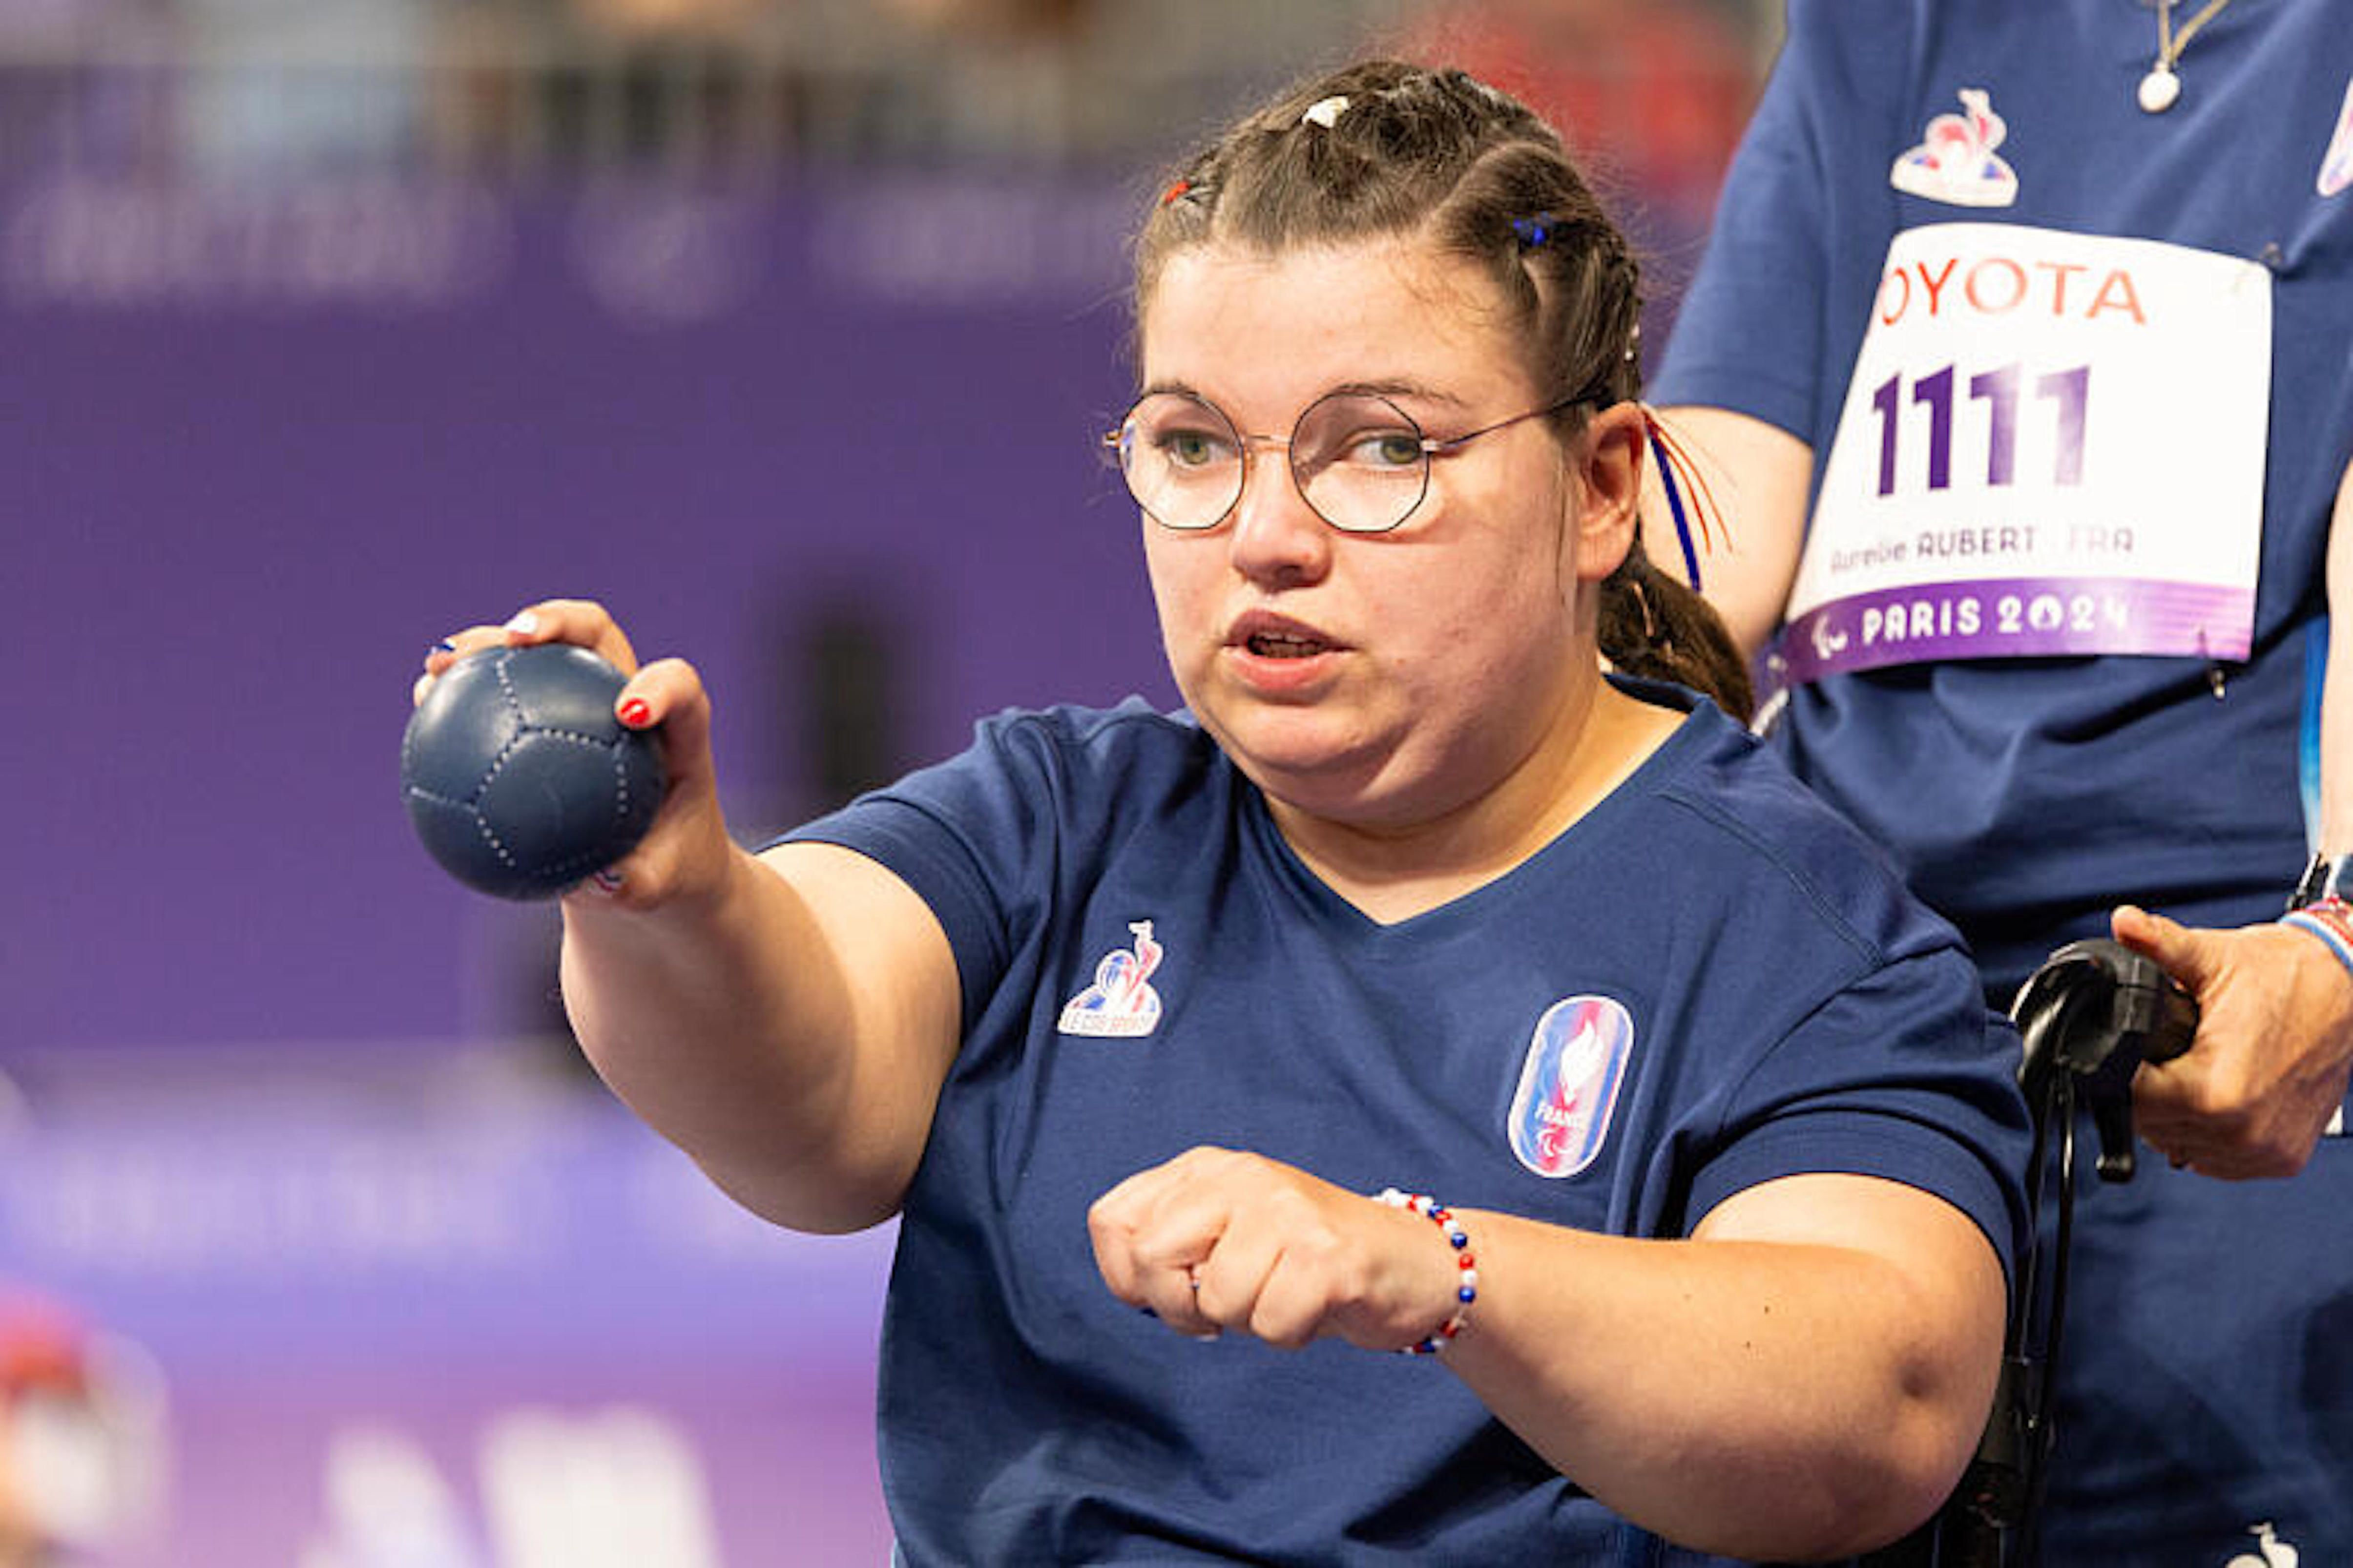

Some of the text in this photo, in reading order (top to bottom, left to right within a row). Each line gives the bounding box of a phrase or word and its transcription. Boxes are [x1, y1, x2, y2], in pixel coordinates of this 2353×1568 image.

[1880, 254, 2147, 327] OYOTA
[1873, 363, 2091, 497] 1111
[1918, 526, 2035, 557] AUBERT
[2069, 525, 2134, 553] FRA
[1861, 594, 2128, 646] PARIS 2024
